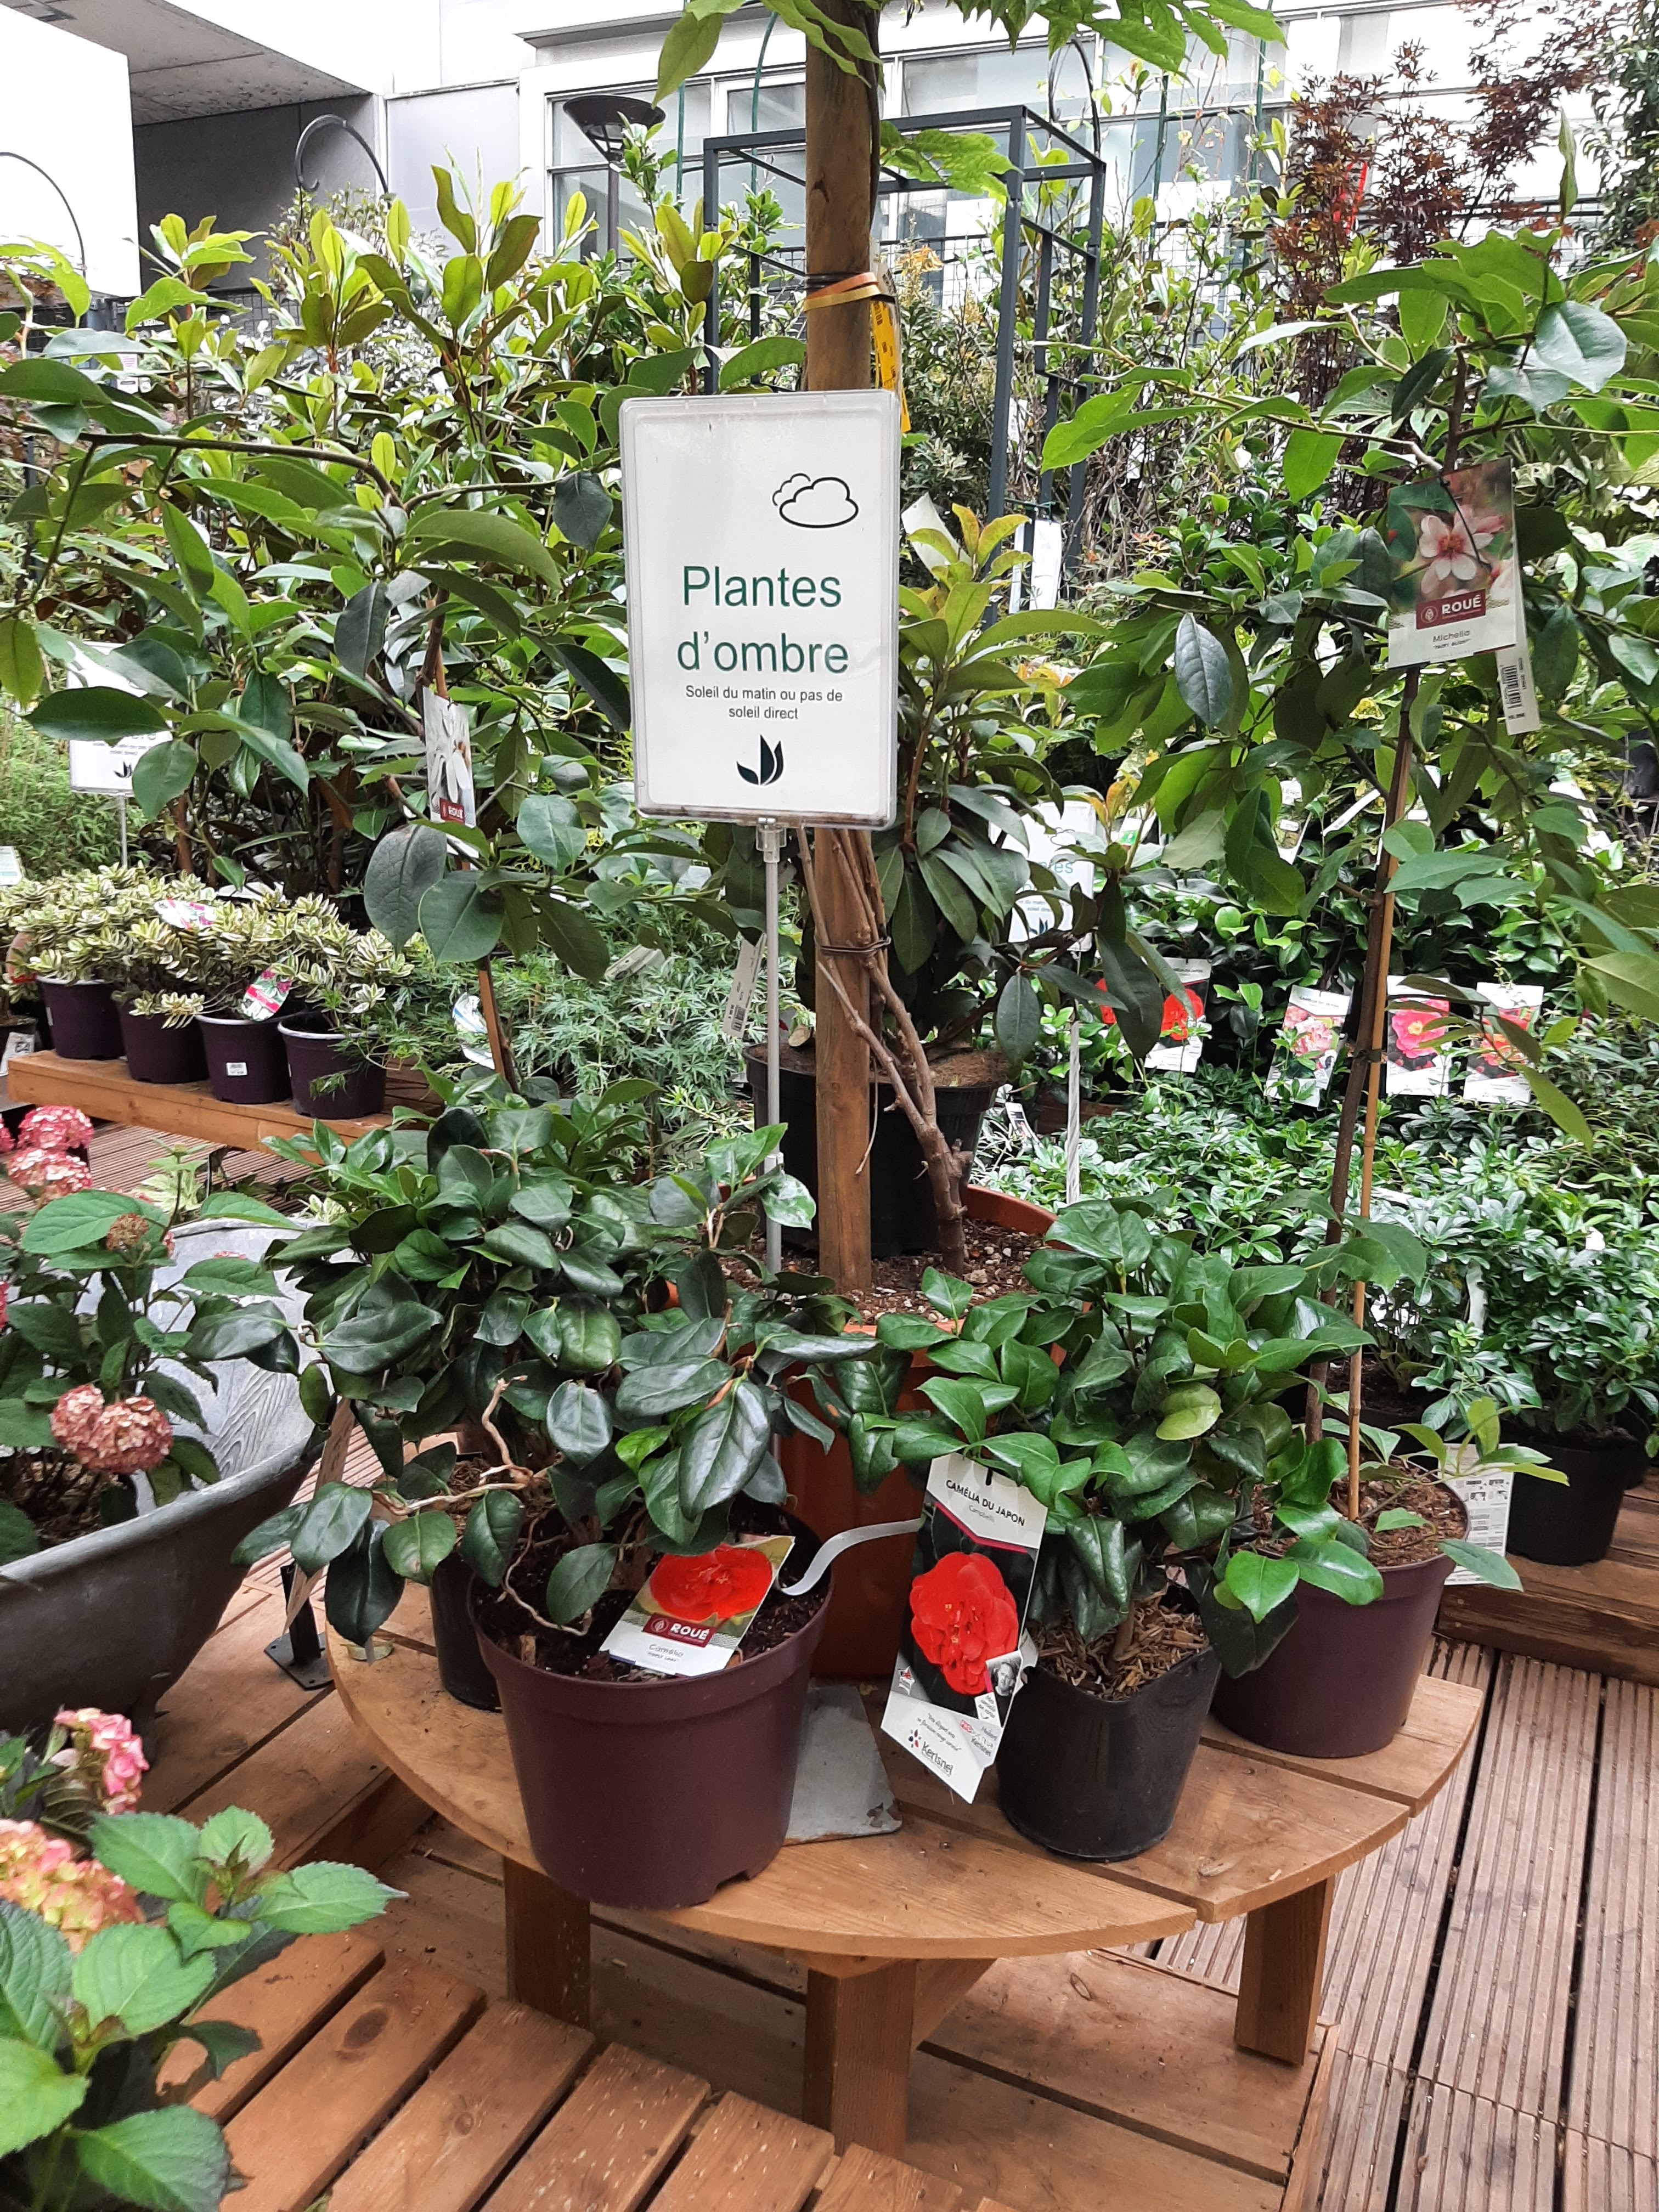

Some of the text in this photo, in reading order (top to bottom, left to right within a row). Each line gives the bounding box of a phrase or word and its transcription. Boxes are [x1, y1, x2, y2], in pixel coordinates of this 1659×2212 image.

[684, 566, 842, 608] Plantes
[1441, 594, 1482, 614] ROUÉ
[686, 685, 843, 703] Soleil du matin ou pas de
[729, 706, 799, 719] soleil direct
[946, 1480, 980, 1504] CAMÉLIA
[981, 1498, 995, 1510] DU
[996, 1505, 1025, 1526] JAPON
[670, 1623, 710, 1640] ROUÉ
